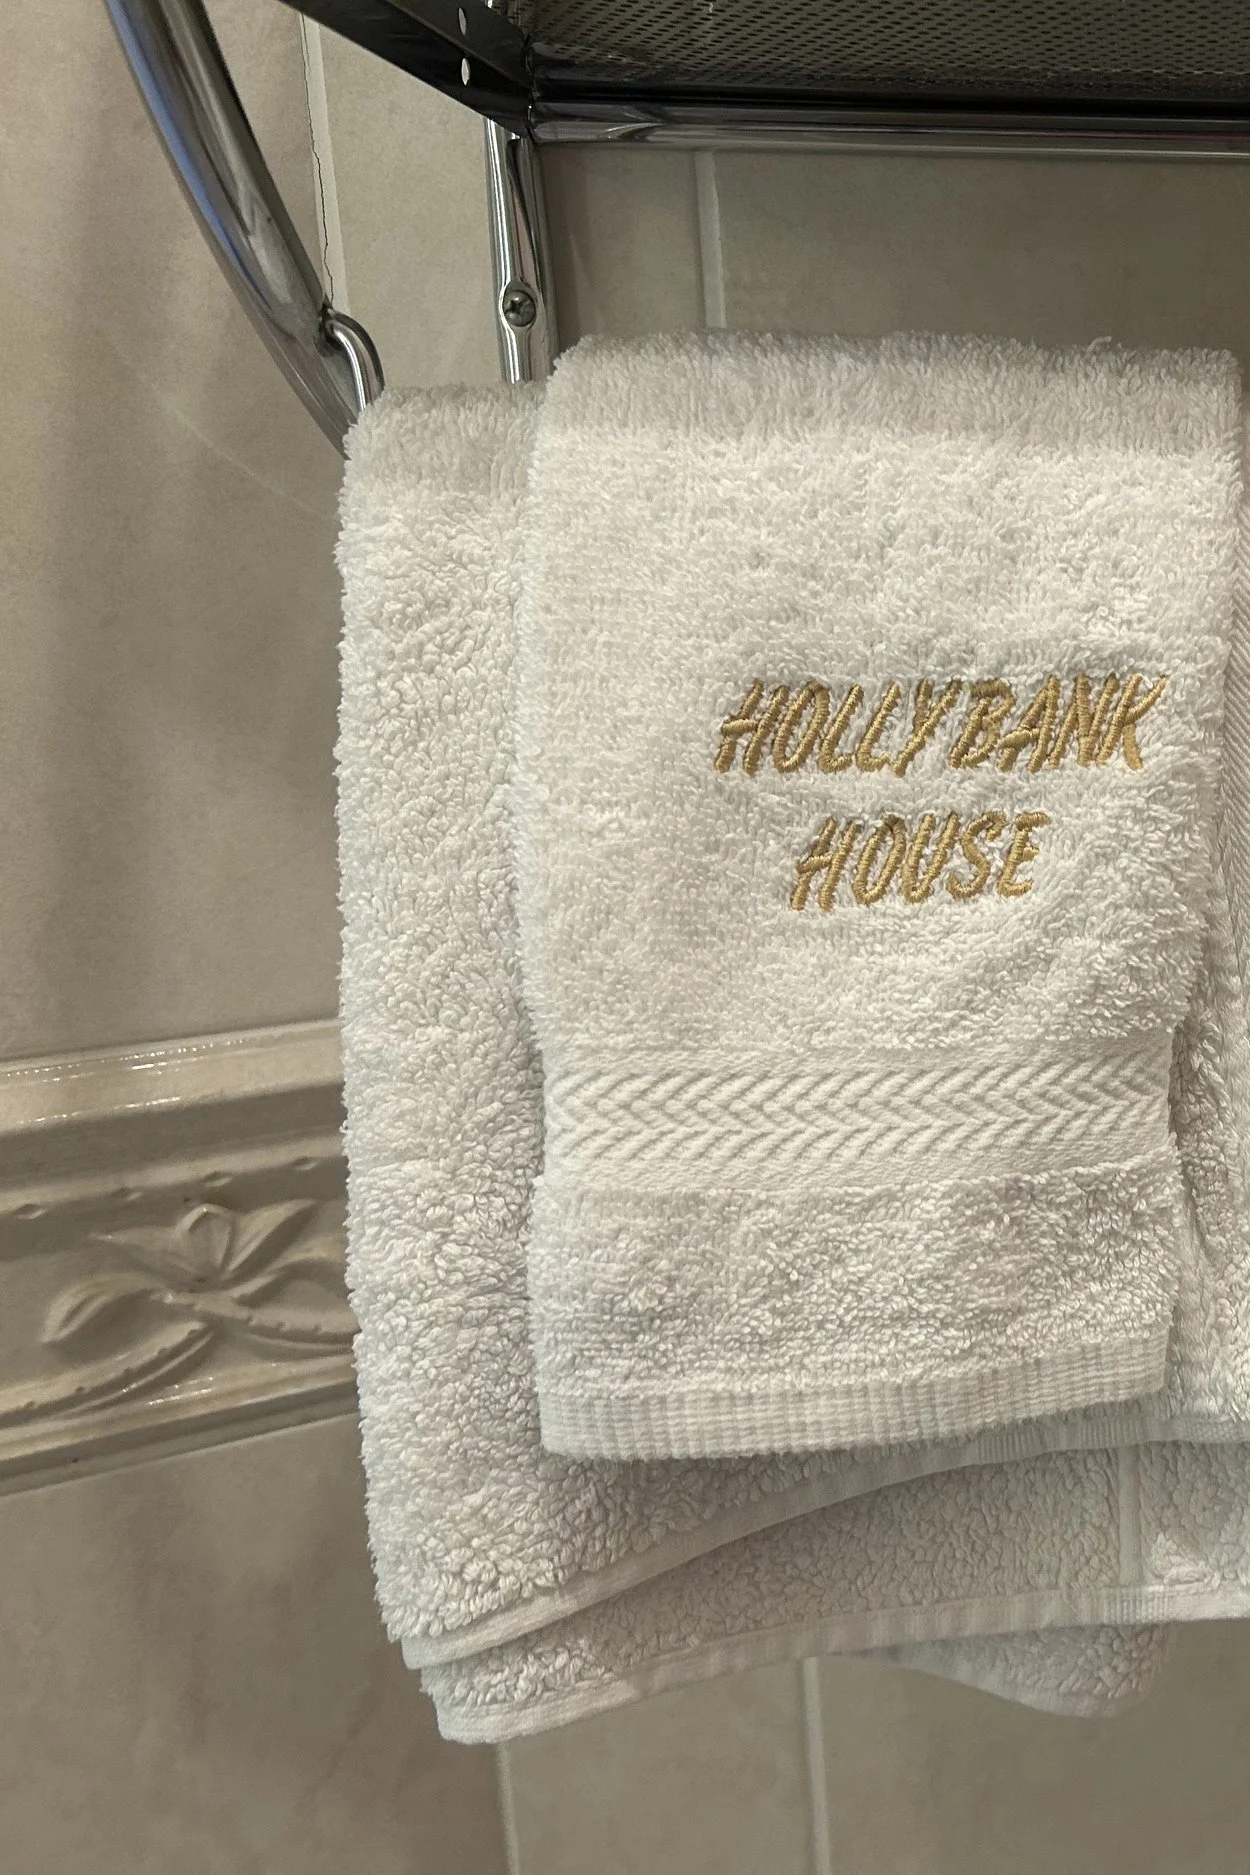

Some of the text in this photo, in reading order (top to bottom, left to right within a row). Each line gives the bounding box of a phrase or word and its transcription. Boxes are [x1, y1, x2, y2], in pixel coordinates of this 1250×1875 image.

[714, 673, 1168, 776] HOLLY BANK
[790, 810, 1051, 911] HOUSE
